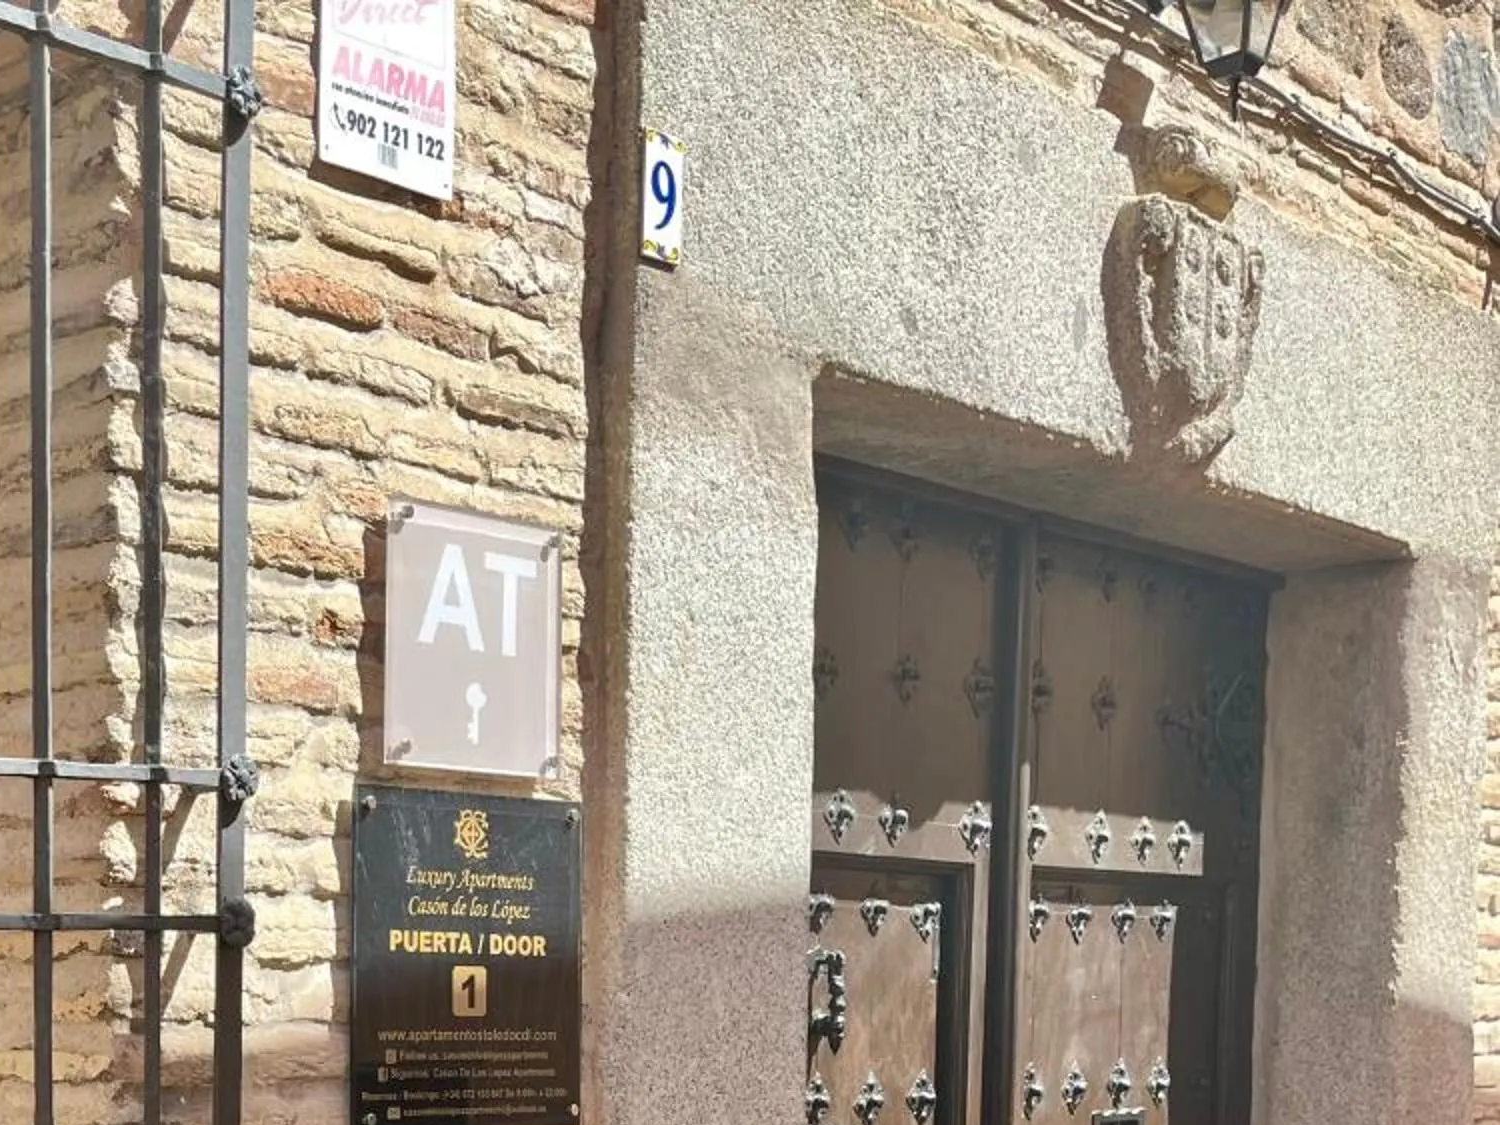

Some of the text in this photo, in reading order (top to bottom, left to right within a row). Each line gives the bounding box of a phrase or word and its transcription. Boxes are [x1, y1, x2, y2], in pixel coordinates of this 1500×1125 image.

[331, 45, 446, 109] ALARMA
[346, 109, 377, 139] 902
[382, 119, 409, 150] 121
[416, 128, 445, 161] 122
[651, 160, 677, 230] 9
[416, 543, 537, 657] AT
[405, 866, 535, 892] Luxury Apartments
[408, 896, 531, 924] Casón de los López
[389, 929, 547, 957] PUERTA / DOOR
[461, 974, 476, 1009] 1
